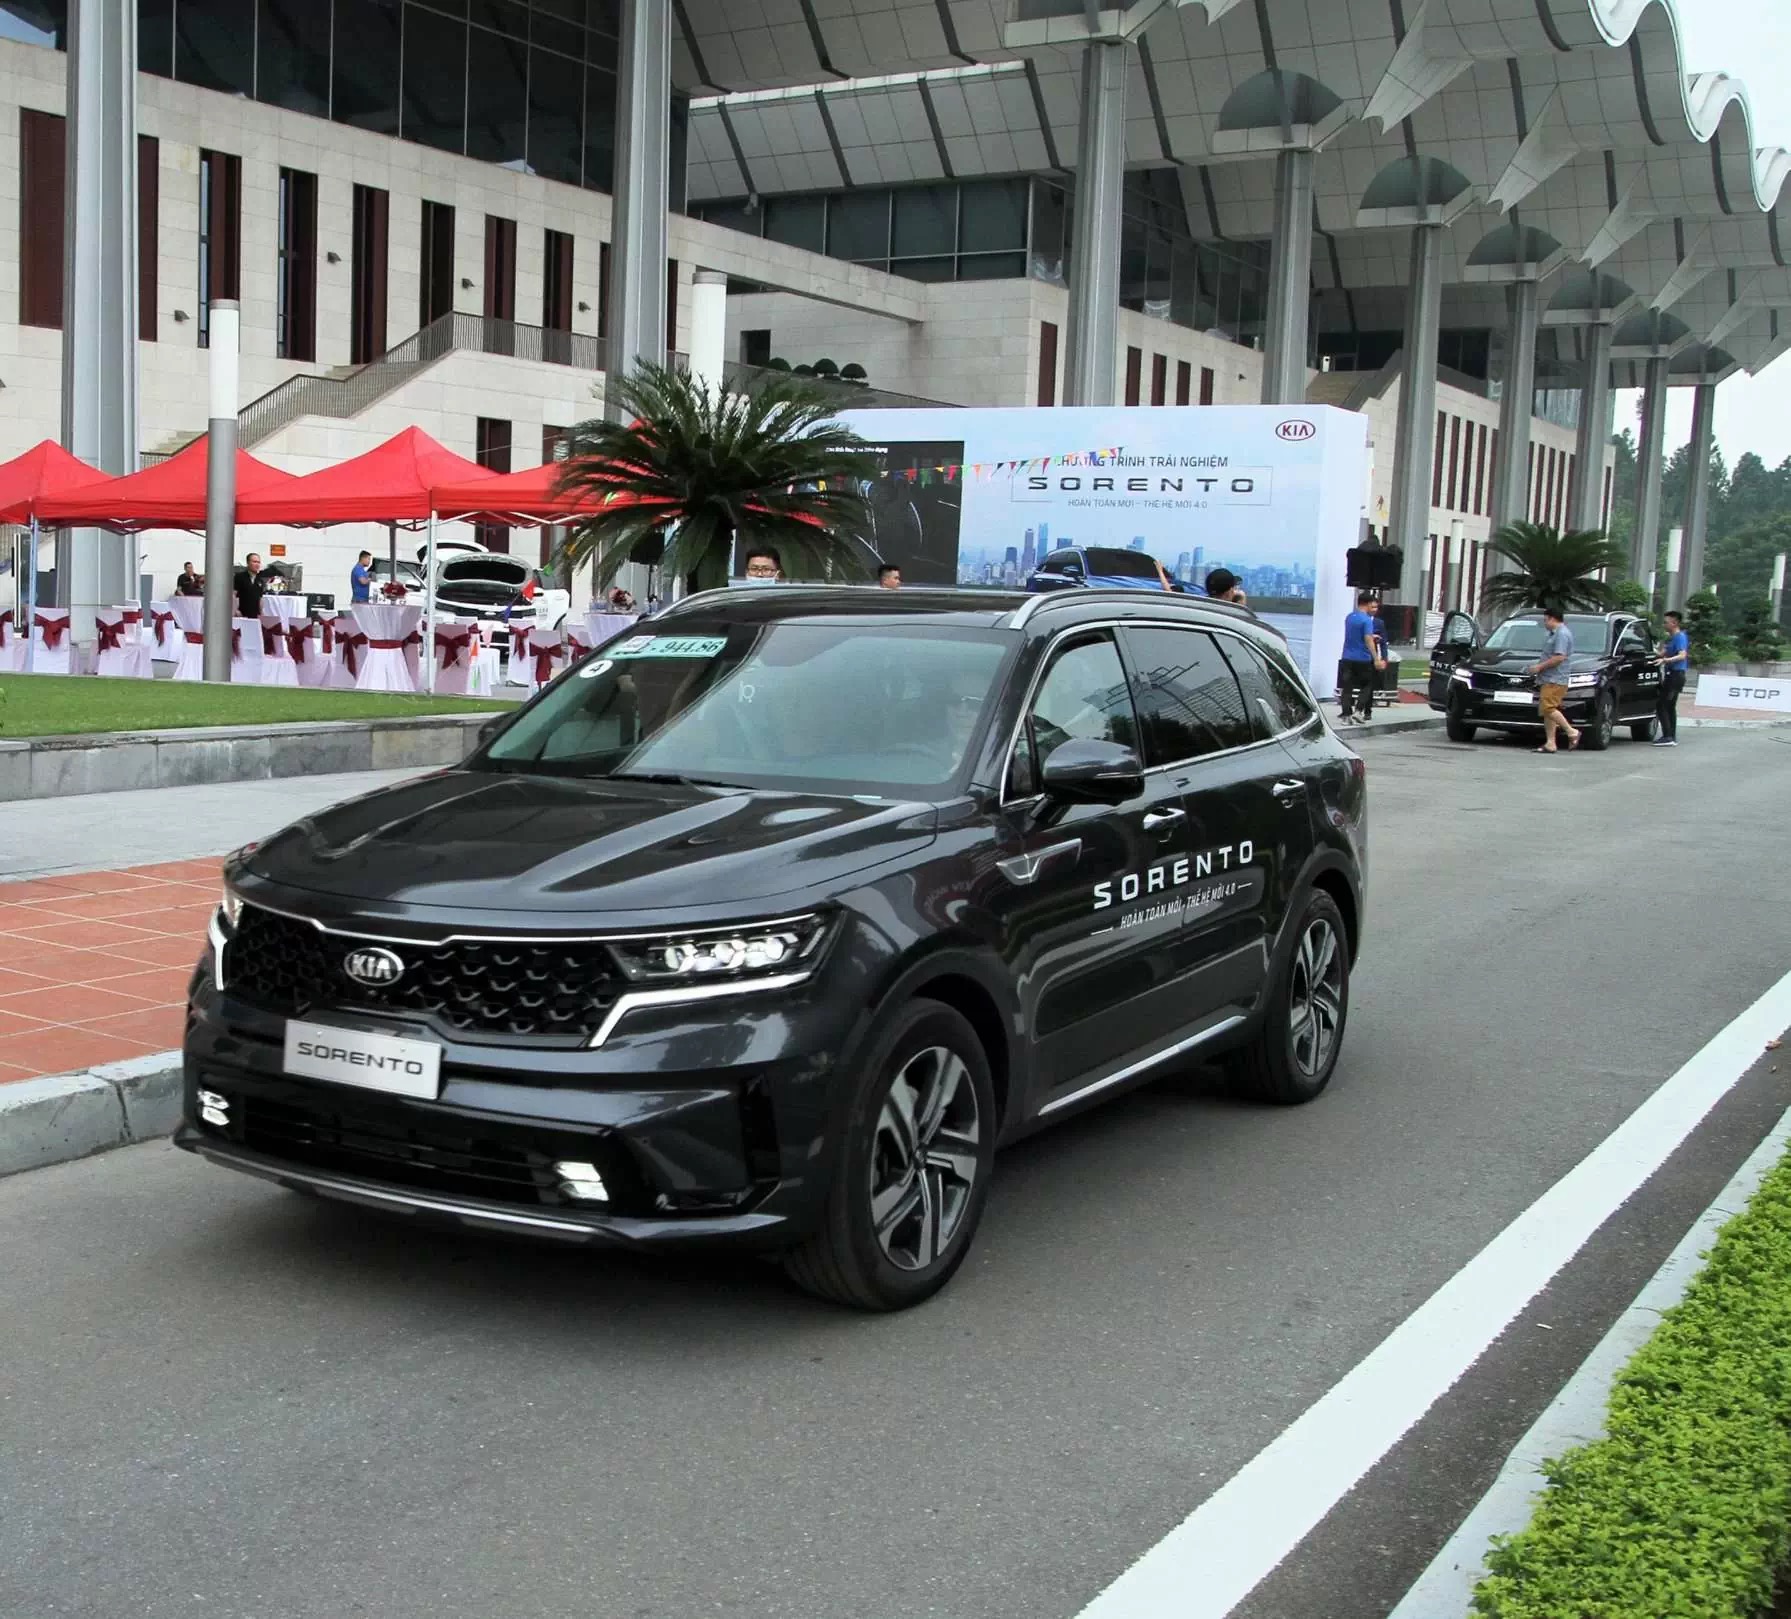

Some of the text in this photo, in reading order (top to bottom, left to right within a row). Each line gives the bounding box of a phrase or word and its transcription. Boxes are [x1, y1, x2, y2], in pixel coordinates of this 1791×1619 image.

[1281, 424, 1309, 437] KIA
[1028, 476, 1255, 493] SORENTO
[1728, 687, 1780, 700] STOP
[1094, 840, 1253, 909] SORENTO
[351, 954, 392, 980] KIA
[297, 1042, 423, 1075] SORENTO
